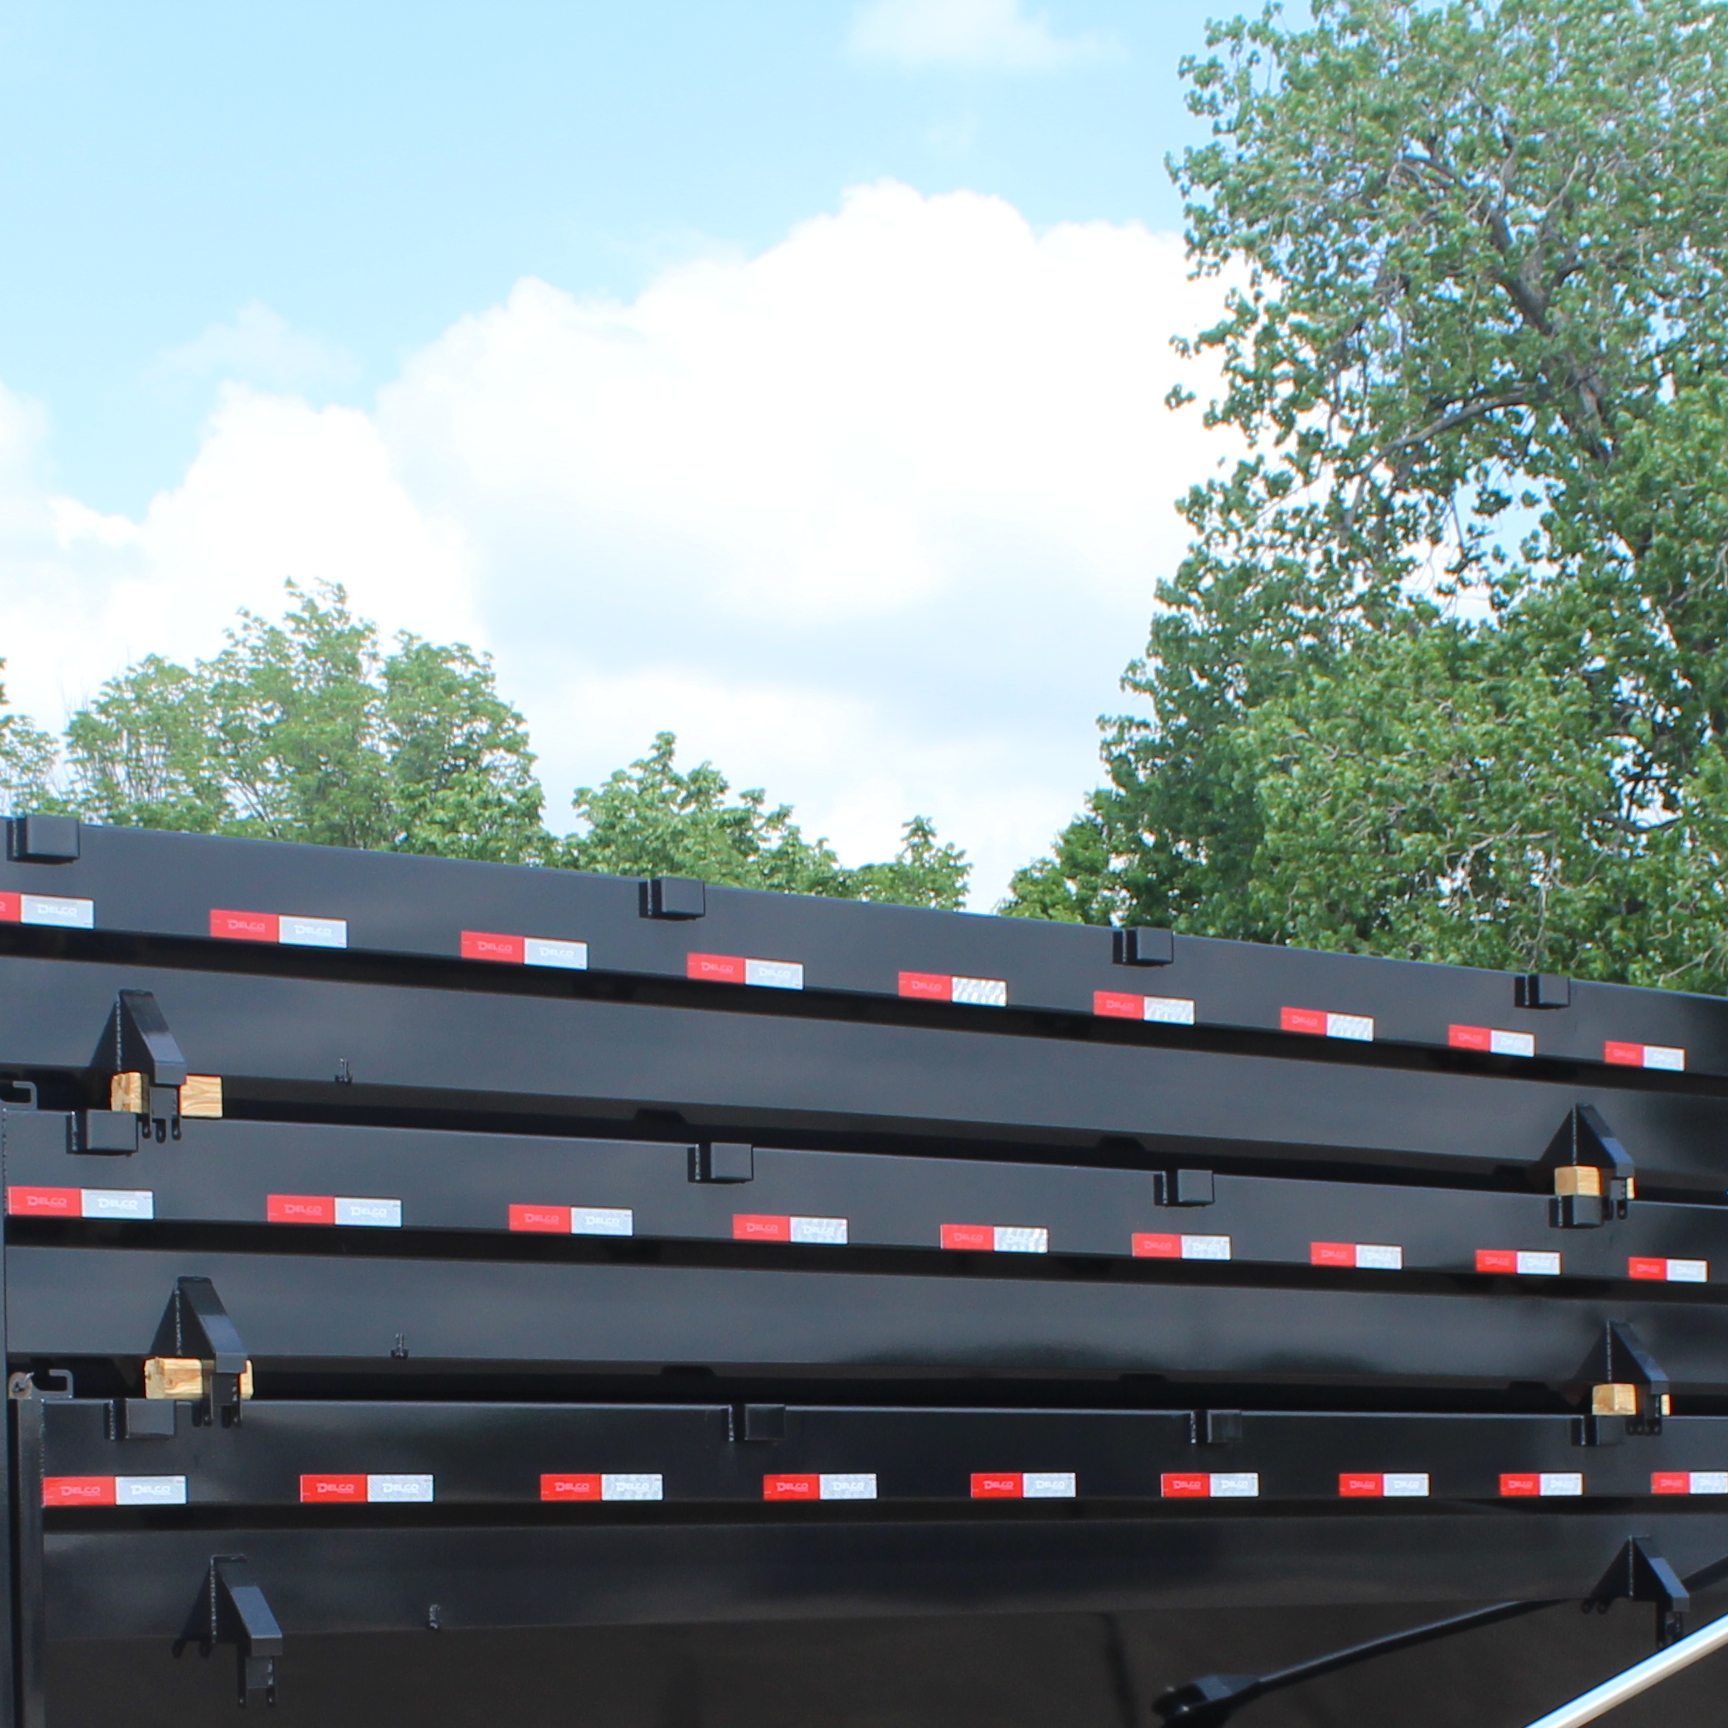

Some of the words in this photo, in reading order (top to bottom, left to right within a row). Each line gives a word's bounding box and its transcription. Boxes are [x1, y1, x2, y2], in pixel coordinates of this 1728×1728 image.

[37, 903, 77, 917] DELCO
[227, 919, 266, 931] DELCO
[294, 924, 332, 937] DELCO
[477, 940, 513, 951] DELCO
[539, 946, 573, 957] DELCO
[27, 1195, 67, 1206] DELCO
[97, 1197, 138, 1210] DELCO
[284, 1204, 322, 1214] DELCO
[350, 1206, 387, 1218] DELCO
[60, 1485, 101, 1496] DELCO
[130, 1484, 171, 1496] DELCO
[316, 1482, 355, 1493] DELCO
[382, 1482, 419, 1493] DELCO
[555, 1481, 590, 1492] DELCO
[615, 1481, 649, 1492] DELCO
